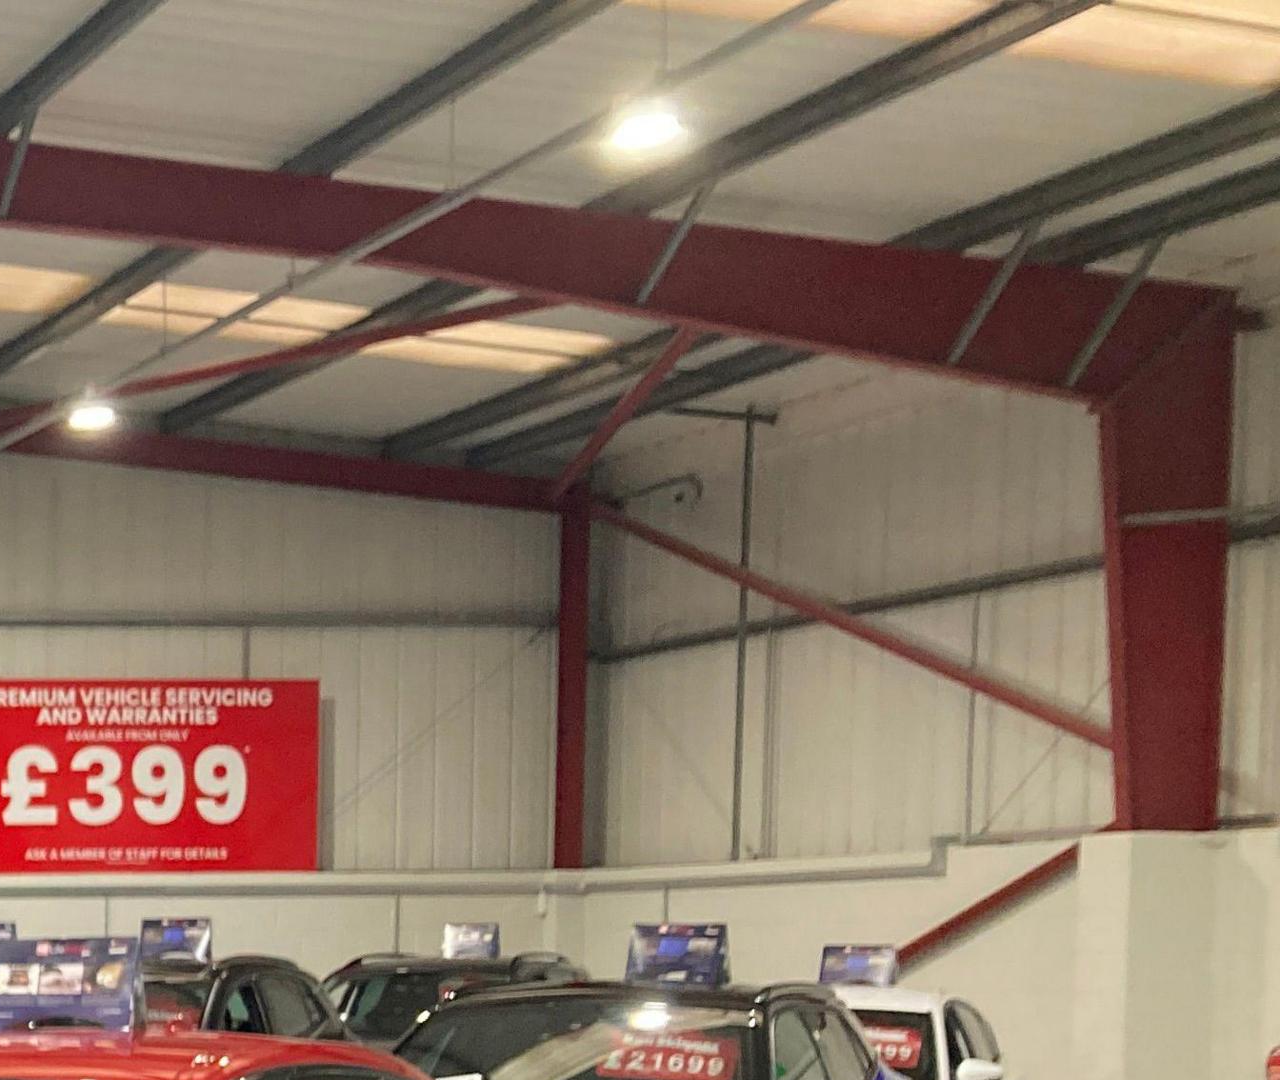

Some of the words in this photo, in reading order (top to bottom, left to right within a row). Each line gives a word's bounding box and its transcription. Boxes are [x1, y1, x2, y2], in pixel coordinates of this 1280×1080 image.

[80, 687, 161, 707] VEHICLE
[165, 687, 273, 707] SERVICING
[36, 706, 82, 725] AND
[87, 706, 218, 726] WARRANTIES
